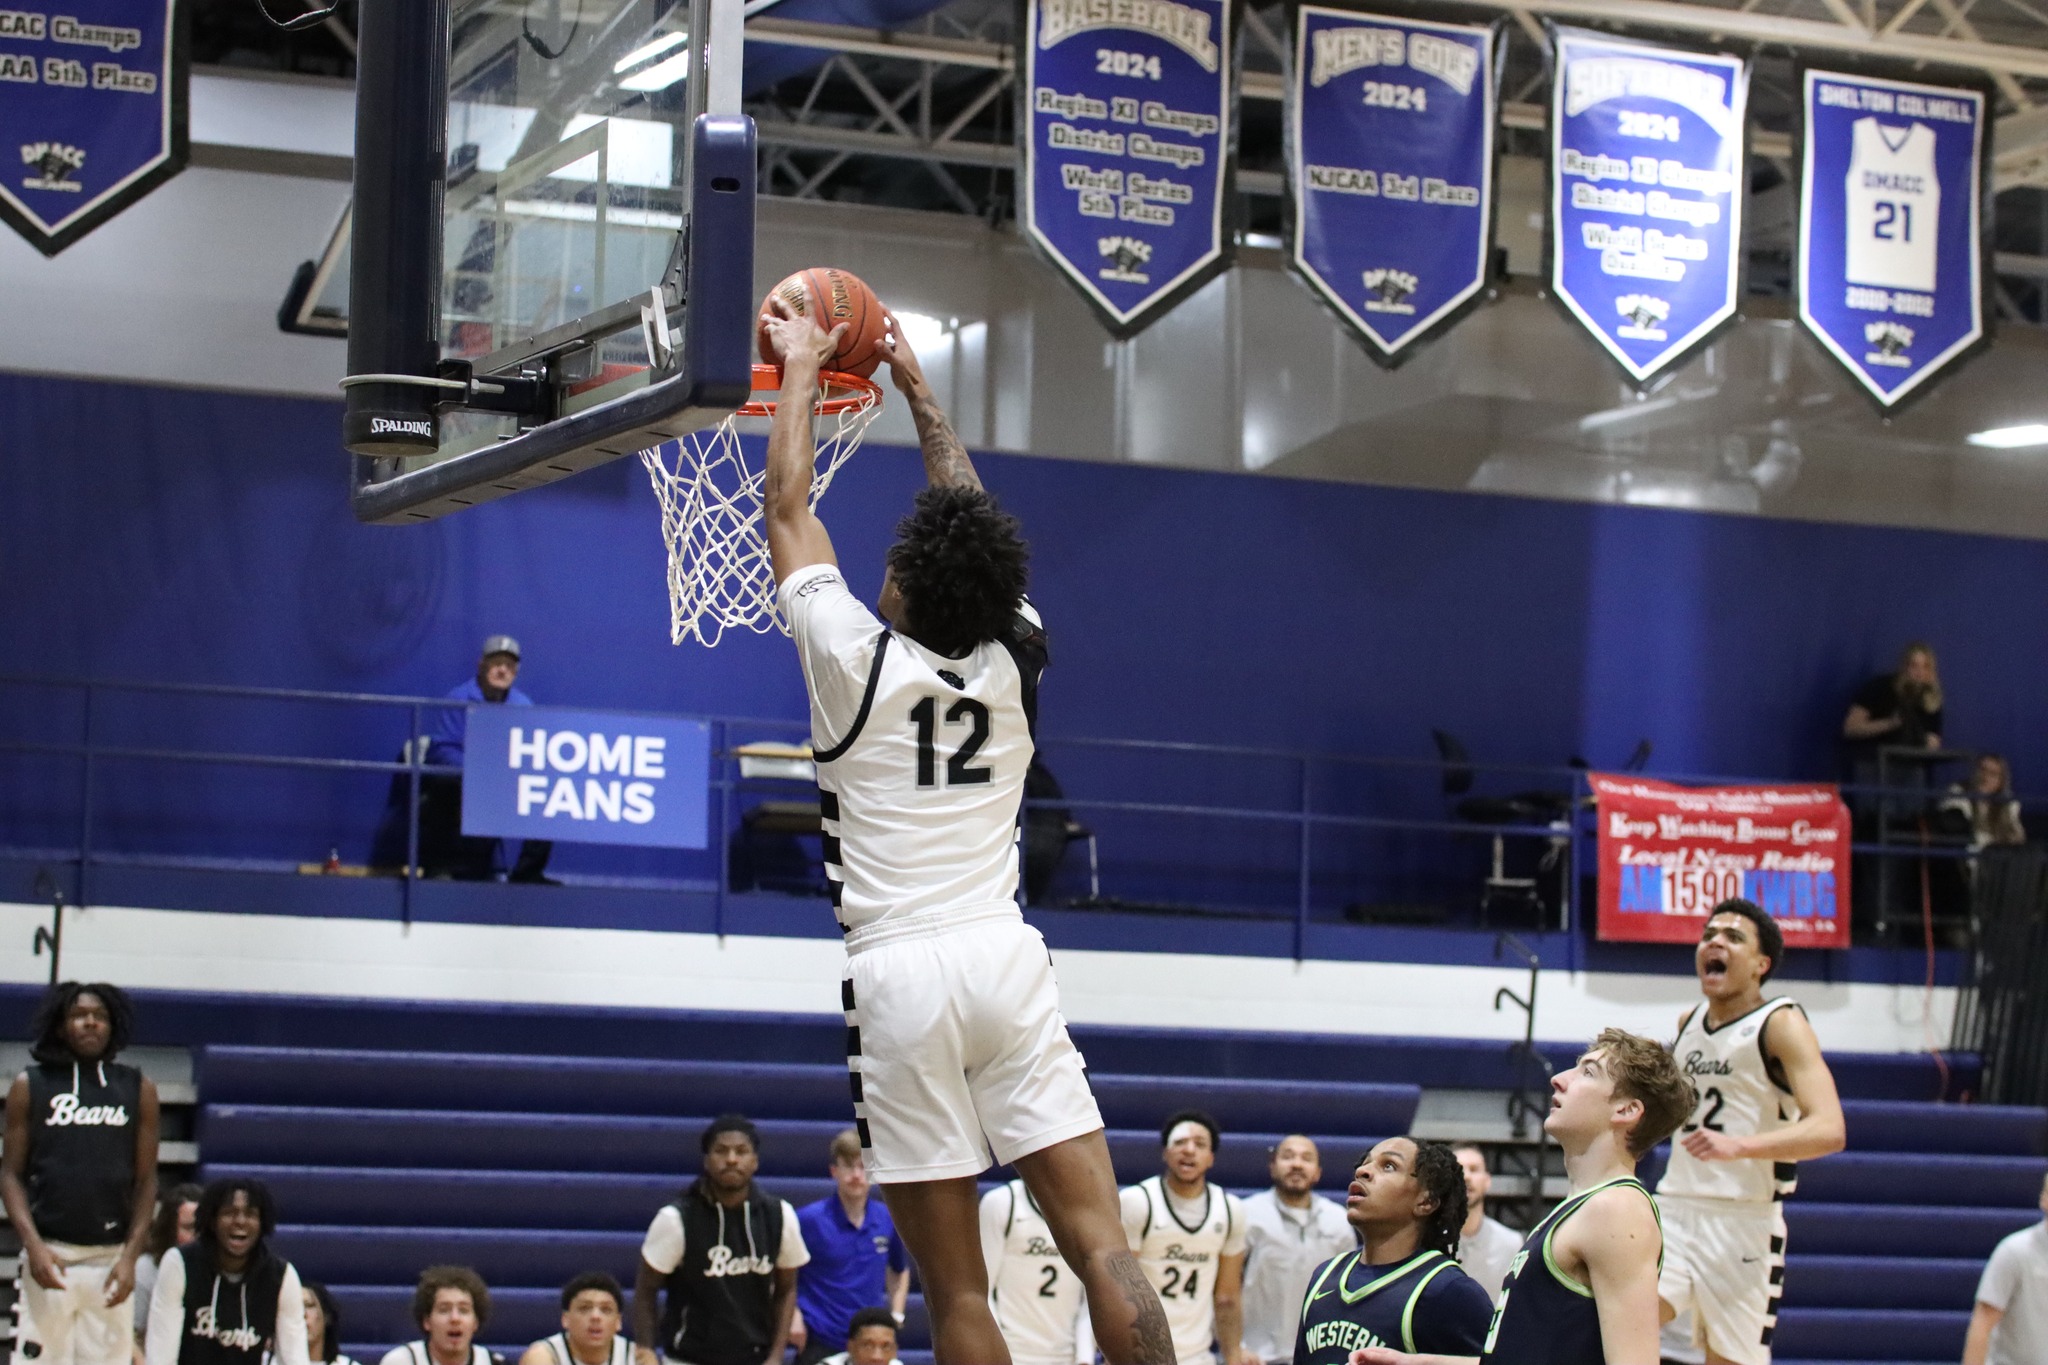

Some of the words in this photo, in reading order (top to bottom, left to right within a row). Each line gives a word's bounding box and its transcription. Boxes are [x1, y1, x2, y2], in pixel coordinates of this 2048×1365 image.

[53, 18, 138, 49] Champs
[1040, 0, 1217, 71] BASEBALL
[46, 60, 85, 85] 5th
[95, 65, 155, 91] Place
[1096, 49, 1161, 80] 2024
[1038, 89, 1106, 118] Region
[1113, 99, 1137, 121] XI
[1144, 104, 1216, 134] Champs
[1363, 81, 1427, 111] 2024
[1819, 84, 1894, 113] SHELTON
[1618, 110, 1680, 142] 2024
[1051, 125, 1123, 152] District
[1130, 135, 1203, 166] Champs
[1063, 167, 1122, 192] World
[1129, 176, 1191, 201] Series
[1308, 167, 1377, 194] NJCAA
[1424, 180, 1477, 204] Place
[1121, 198, 1172, 223] Place
[1874, 201, 1912, 242] 21
[371, 418, 432, 437] SPALDING
[509, 727, 666, 779] HOME
[908, 695, 995, 790] 12
[517, 775, 655, 824] FANS
[1609, 812, 1657, 839] Keep
[1657, 814, 1735, 842] Watching
[1618, 845, 1688, 868] Local
[1687, 848, 1755, 870] News
[1761, 850, 1835, 872] Radio
[1619, 865, 1663, 912] AM
[1665, 869, 1739, 911] 1590
[1683, 1050, 1733, 1075] Bears
[45, 1093, 129, 1126] Bears
[703, 1245, 774, 1277] Bears
[1022, 1236, 1060, 1257] Bea
[1039, 1264, 1058, 1297] 2
[1161, 1266, 1198, 1298] 24
[191, 1306, 261, 1348] Bars
